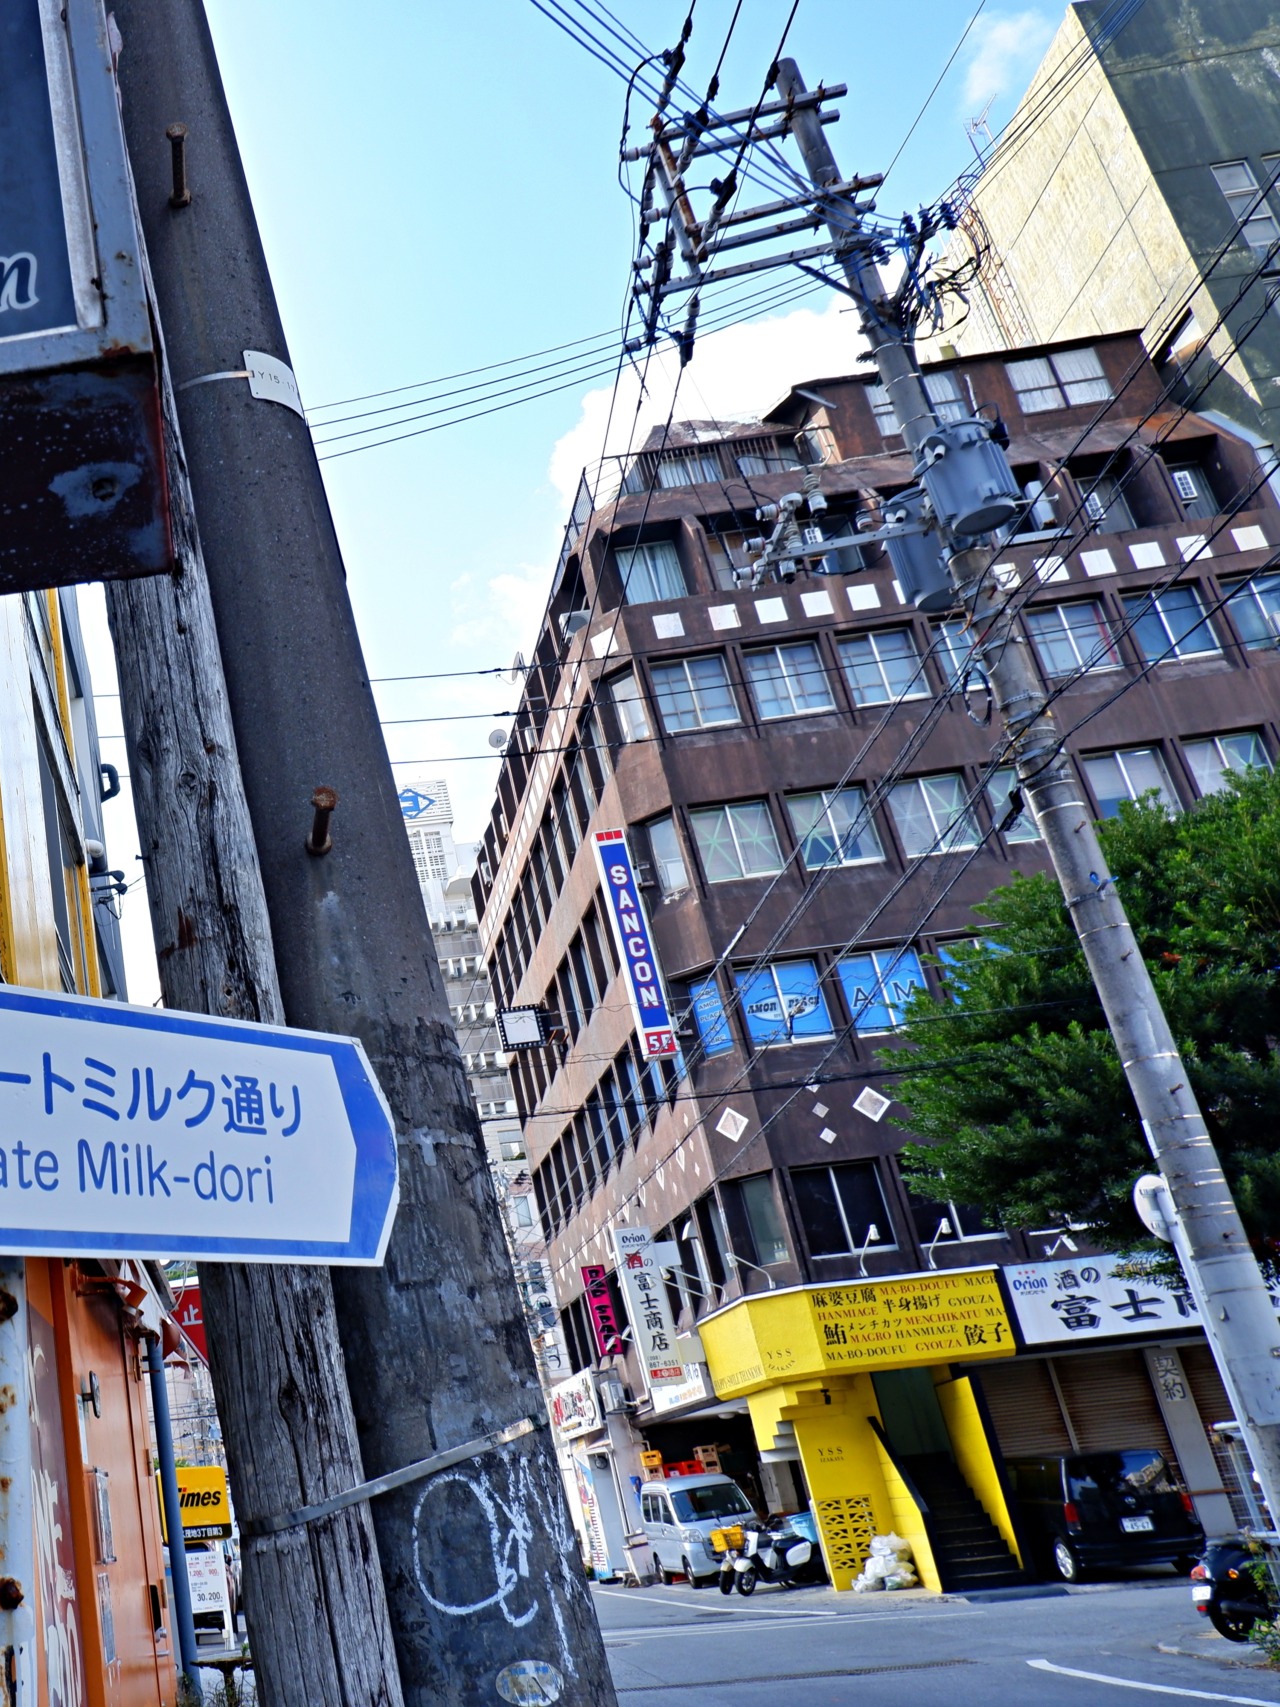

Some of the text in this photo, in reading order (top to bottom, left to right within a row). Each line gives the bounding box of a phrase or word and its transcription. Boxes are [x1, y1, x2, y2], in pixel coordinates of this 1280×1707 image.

[609, 864, 660, 1008] SANCON
[77, 1138, 274, 1204] Milk-dori
[622, 1233, 646, 1243] Orion
[879, 1278, 961, 1296] MA-BO-DOUFU
[1012, 1275, 1048, 1290] Orion
[1054, 1266, 1101, 1291] 酒の
[811, 1287, 877, 1309] 麻婆豆腐
[883, 1294, 941, 1313] 半身揚げ
[948, 1294, 995, 1307] GYOUZA
[634, 1272, 669, 1351] 富士商店
[817, 1306, 879, 1322] HANMIAGE
[905, 1307, 982, 1325] MENCHIKATU
[823, 1323, 848, 1346] 鮪
[849, 1318, 903, 1332] メンチカツ
[850, 1325, 959, 1344] MAGRO HANMIAGE
[963, 1322, 1008, 1346] 餃子
[826, 1338, 963, 1361] MA-BO-DOUFU GYOUZA
[178, 1487, 221, 1508] imes
